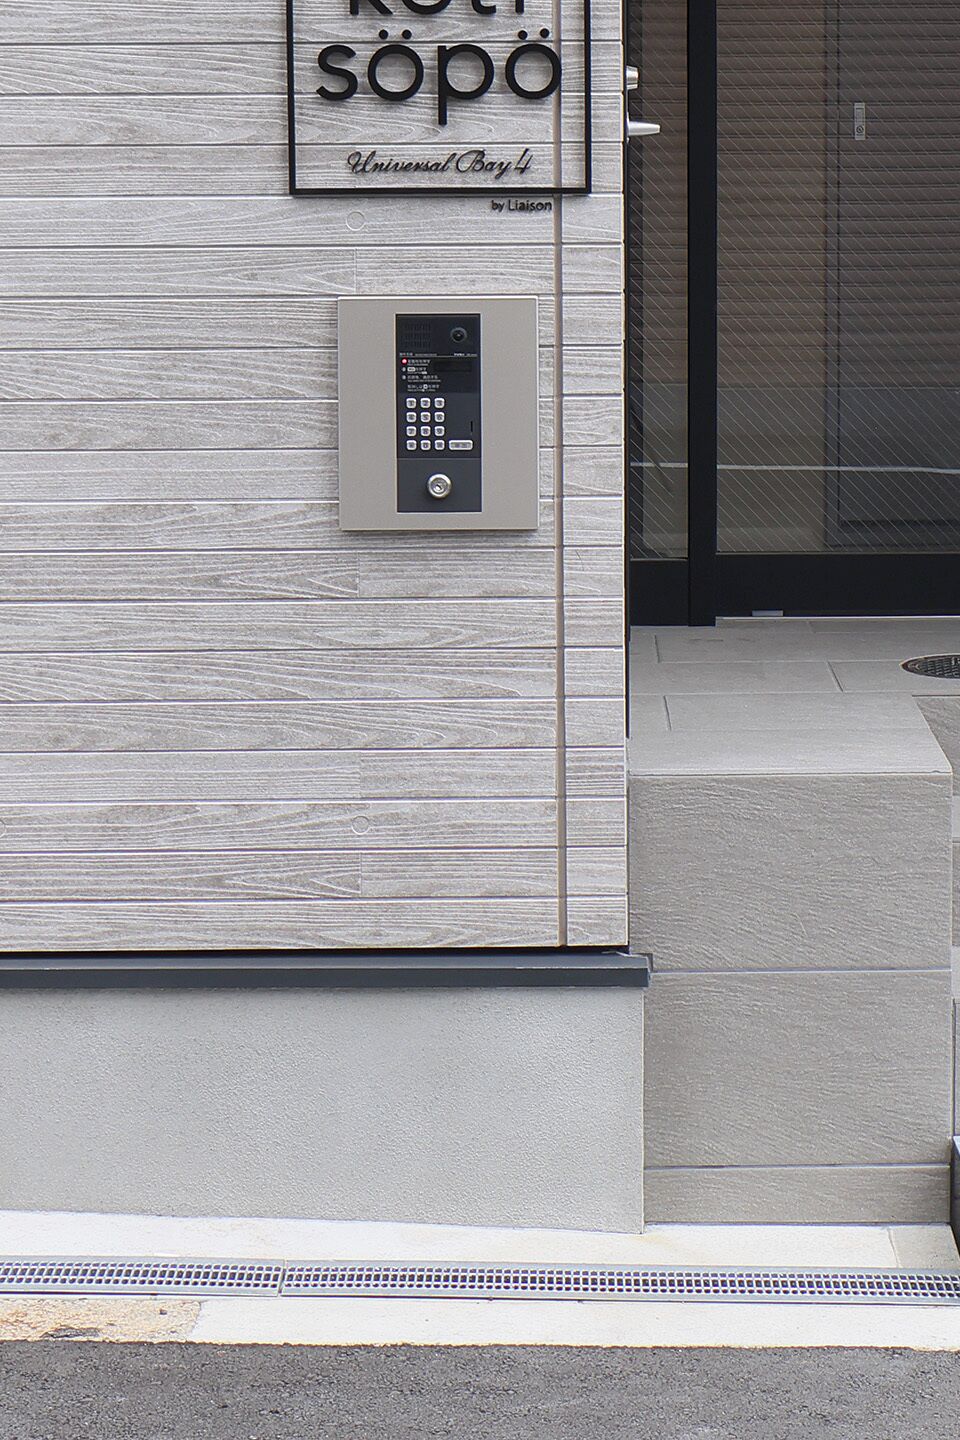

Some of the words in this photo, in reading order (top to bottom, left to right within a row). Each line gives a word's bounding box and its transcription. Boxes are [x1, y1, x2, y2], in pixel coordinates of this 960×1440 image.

[315, 28, 563, 127] söpö
[347, 150, 457, 175] Universal
[456, 149, 512, 180] Bay
[514, 147, 534, 175] 4
[491, 199, 505, 212] by
[508, 199, 553, 212] Liaison
